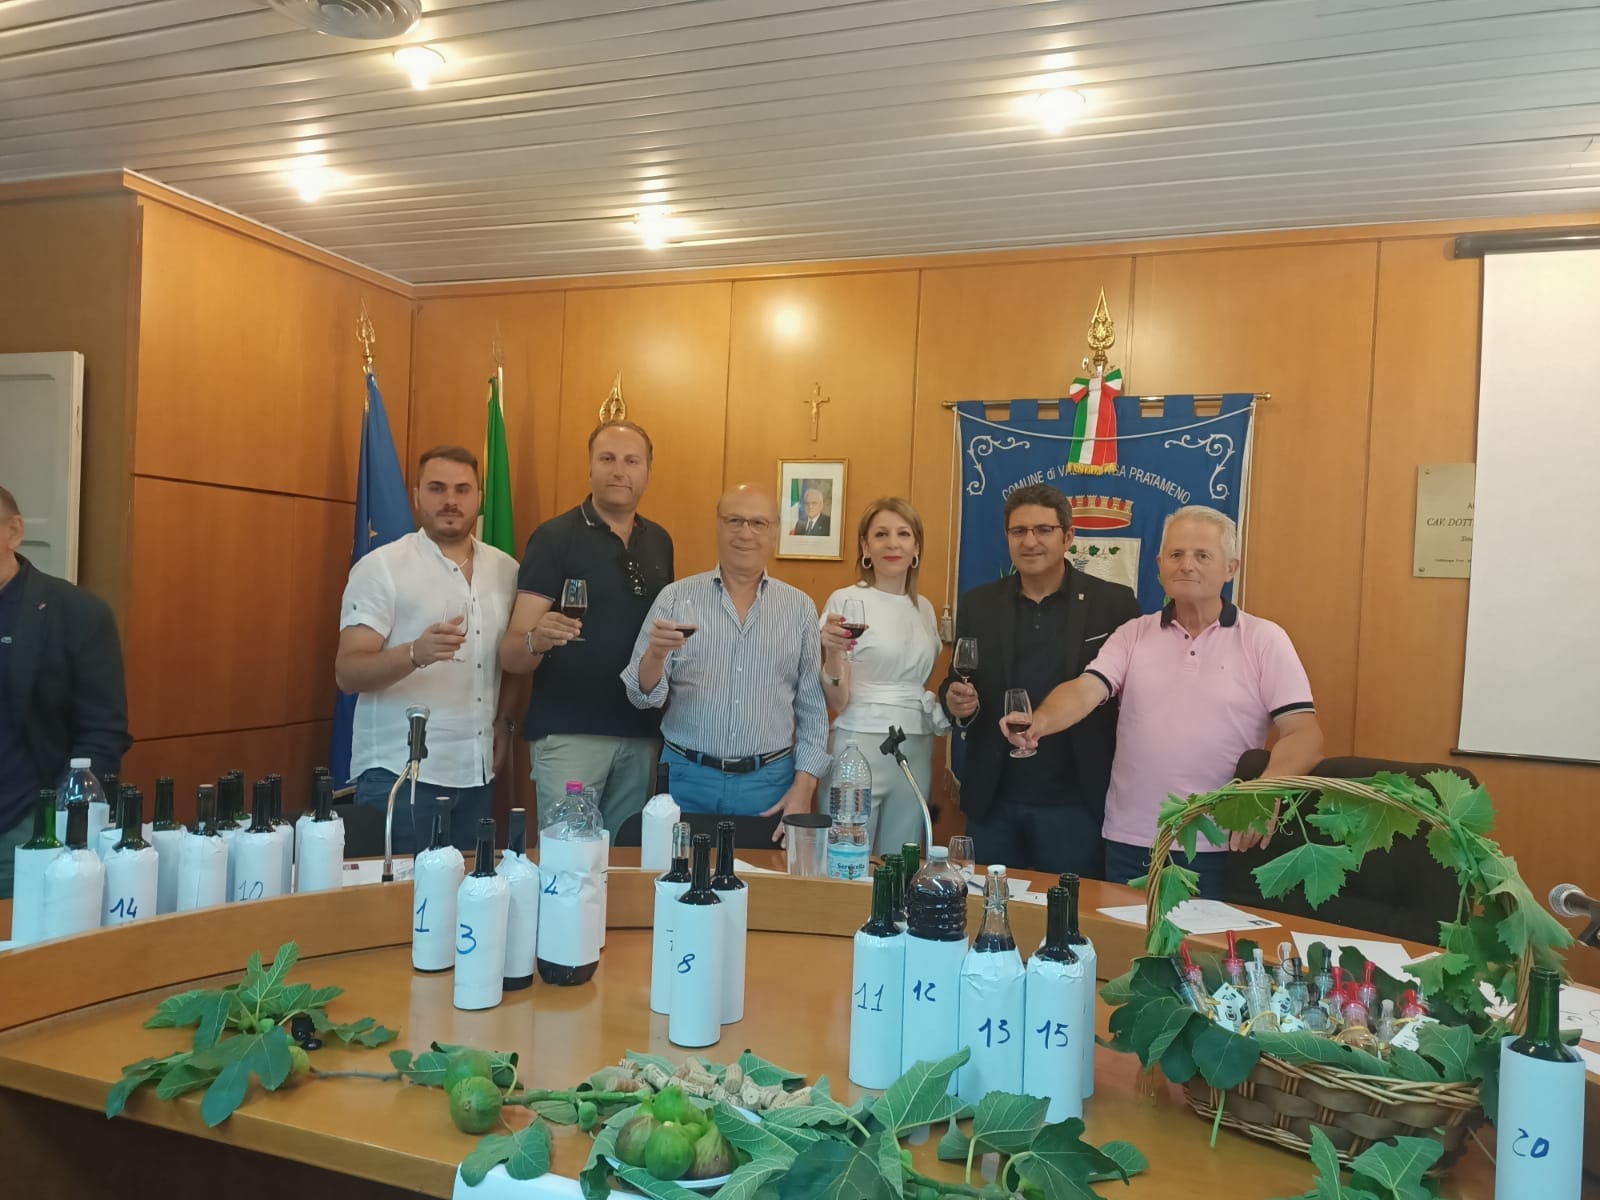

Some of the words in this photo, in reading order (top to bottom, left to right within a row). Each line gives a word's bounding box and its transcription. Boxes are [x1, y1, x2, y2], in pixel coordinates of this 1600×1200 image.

[1047, 467, 1056, 480] di
[1129, 466, 1191, 504] PRATAMENO
[543, 874, 559, 895] 4
[109, 897, 138, 919] 14
[414, 897, 430, 933] 1
[456, 924, 477, 955] 3
[676, 953, 696, 974] 8
[854, 982, 885, 1012] 11
[978, 1017, 1011, 1048] 13
[1036, 1019, 1069, 1049] 15
